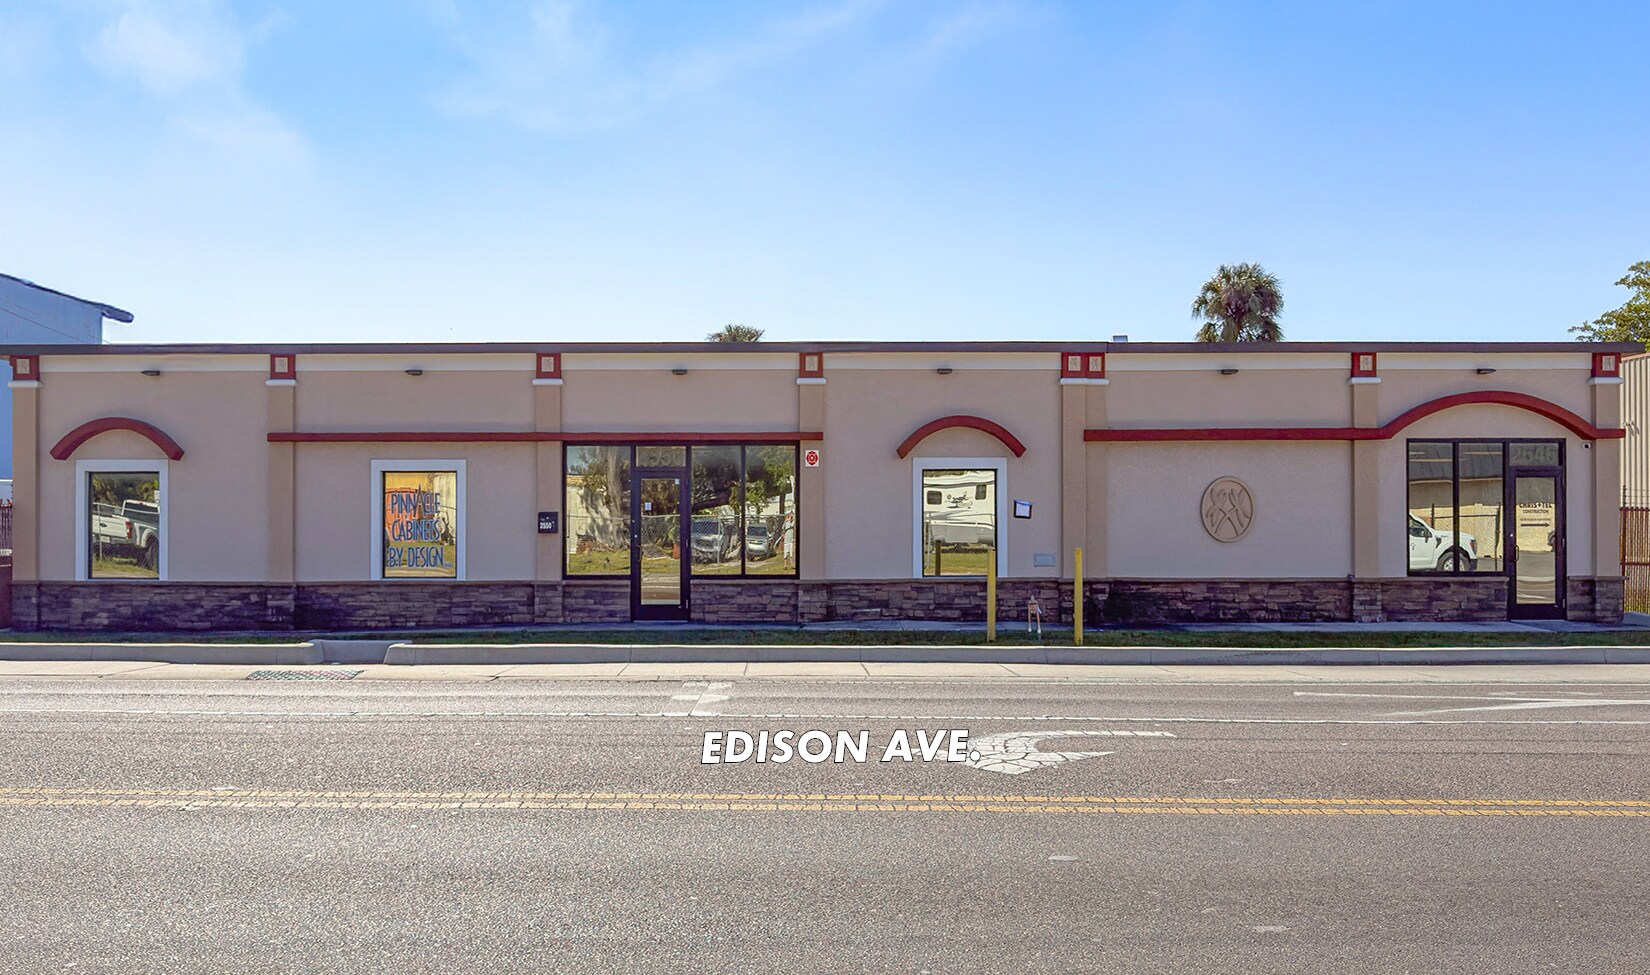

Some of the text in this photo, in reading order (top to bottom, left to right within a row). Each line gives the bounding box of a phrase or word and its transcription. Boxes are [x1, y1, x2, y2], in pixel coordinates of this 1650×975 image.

[391, 484, 440, 518] PINNACLE
[391, 520, 440, 541] CABINETS
[388, 546, 444, 567] BY DESIGN
